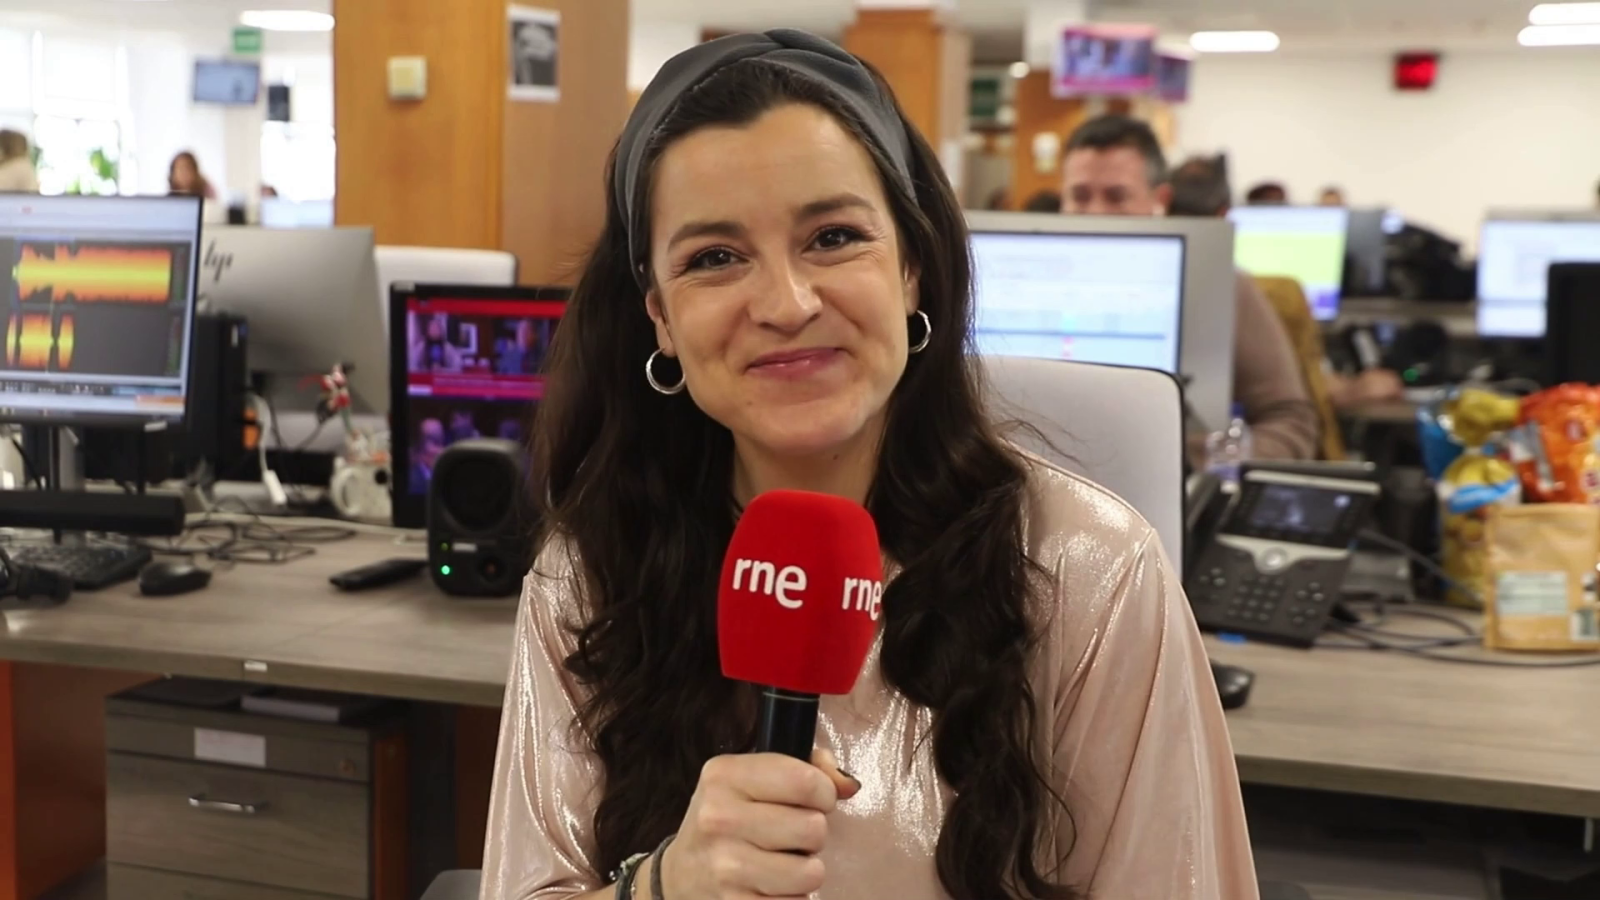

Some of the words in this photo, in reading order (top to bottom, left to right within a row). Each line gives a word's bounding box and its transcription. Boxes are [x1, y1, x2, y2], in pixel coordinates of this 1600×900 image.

[204, 238, 234, 281] hp
[732, 558, 808, 609] rne
[842, 577, 882, 621] rne
